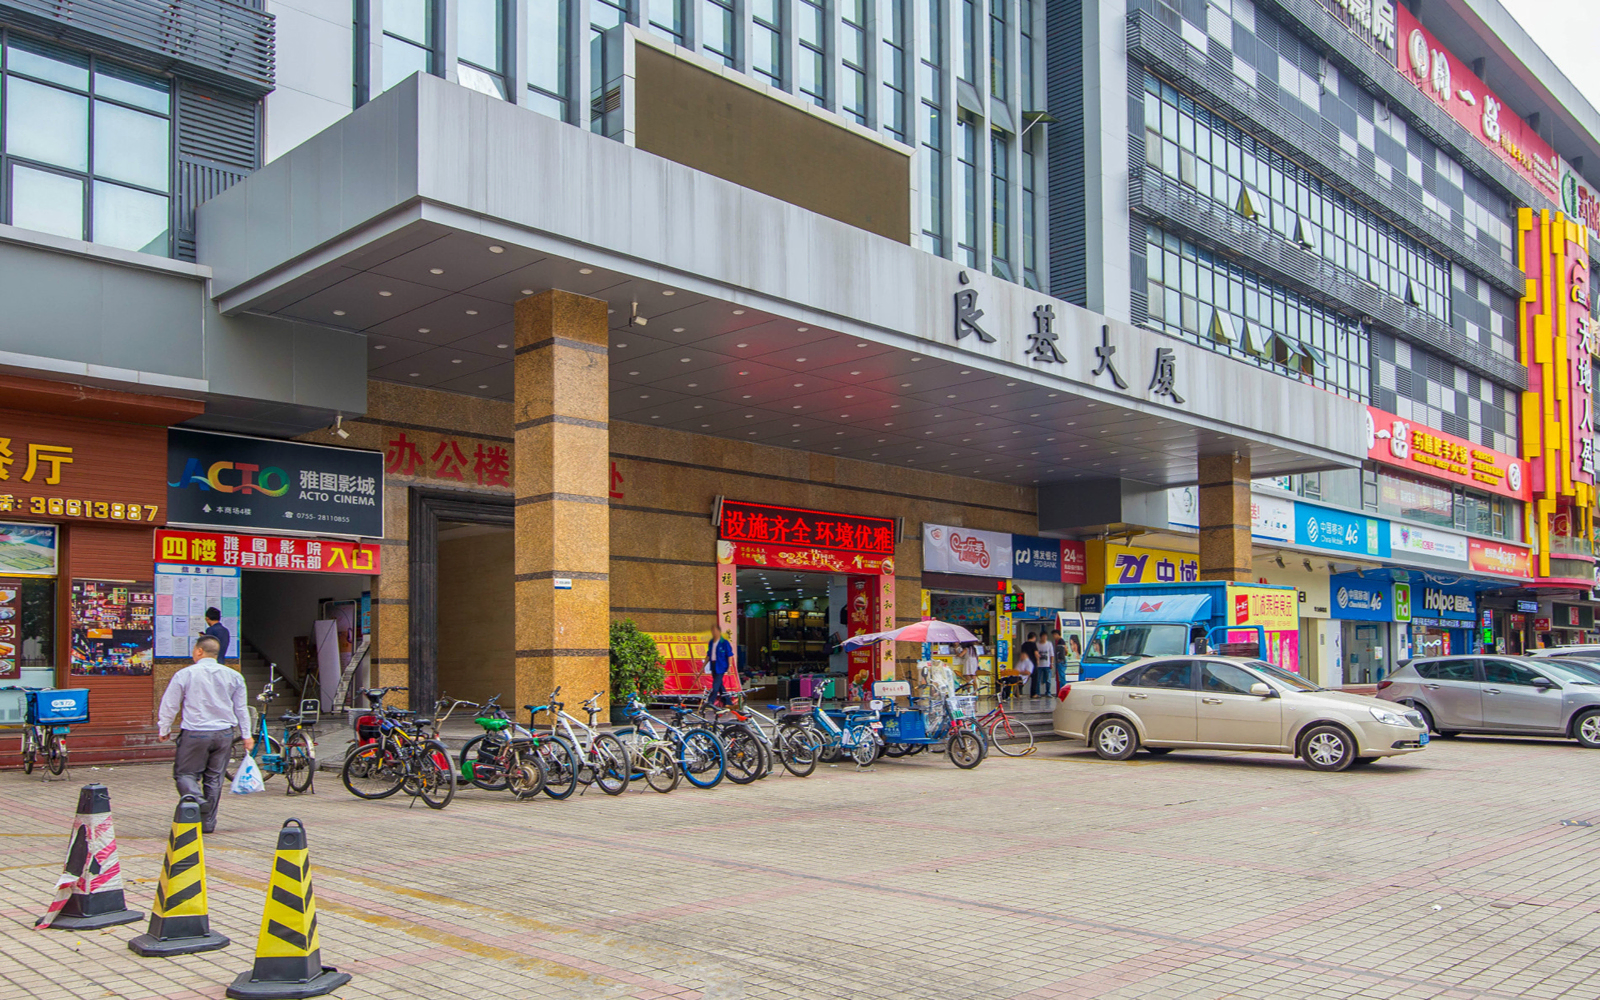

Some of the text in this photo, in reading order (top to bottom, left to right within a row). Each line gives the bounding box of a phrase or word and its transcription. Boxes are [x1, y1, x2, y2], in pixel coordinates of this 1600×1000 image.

[954, 270, 1186, 404] 良基大厦
[385, 432, 511, 488] 办公楼
[174, 457, 290, 498] ACTO
[299, 470, 376, 496] 雅图影城
[299, 491, 376, 507] ACTO CINEMA
[216, 506, 252, 516] 本商场4楼
[724, 510, 892, 552] 设施齐全 环境优雅
[1345, 524, 1358, 545] 4G
[162, 536, 217, 562] 四楼
[223, 535, 322, 556] 雅图影院
[1033, 550, 1057, 561] 浦发银行
[1064, 548, 1076, 563] 24
[223, 550, 322, 570] 好身材俱乐部
[327, 547, 374, 570] 入口
[1370, 592, 1382, 611] 4G
